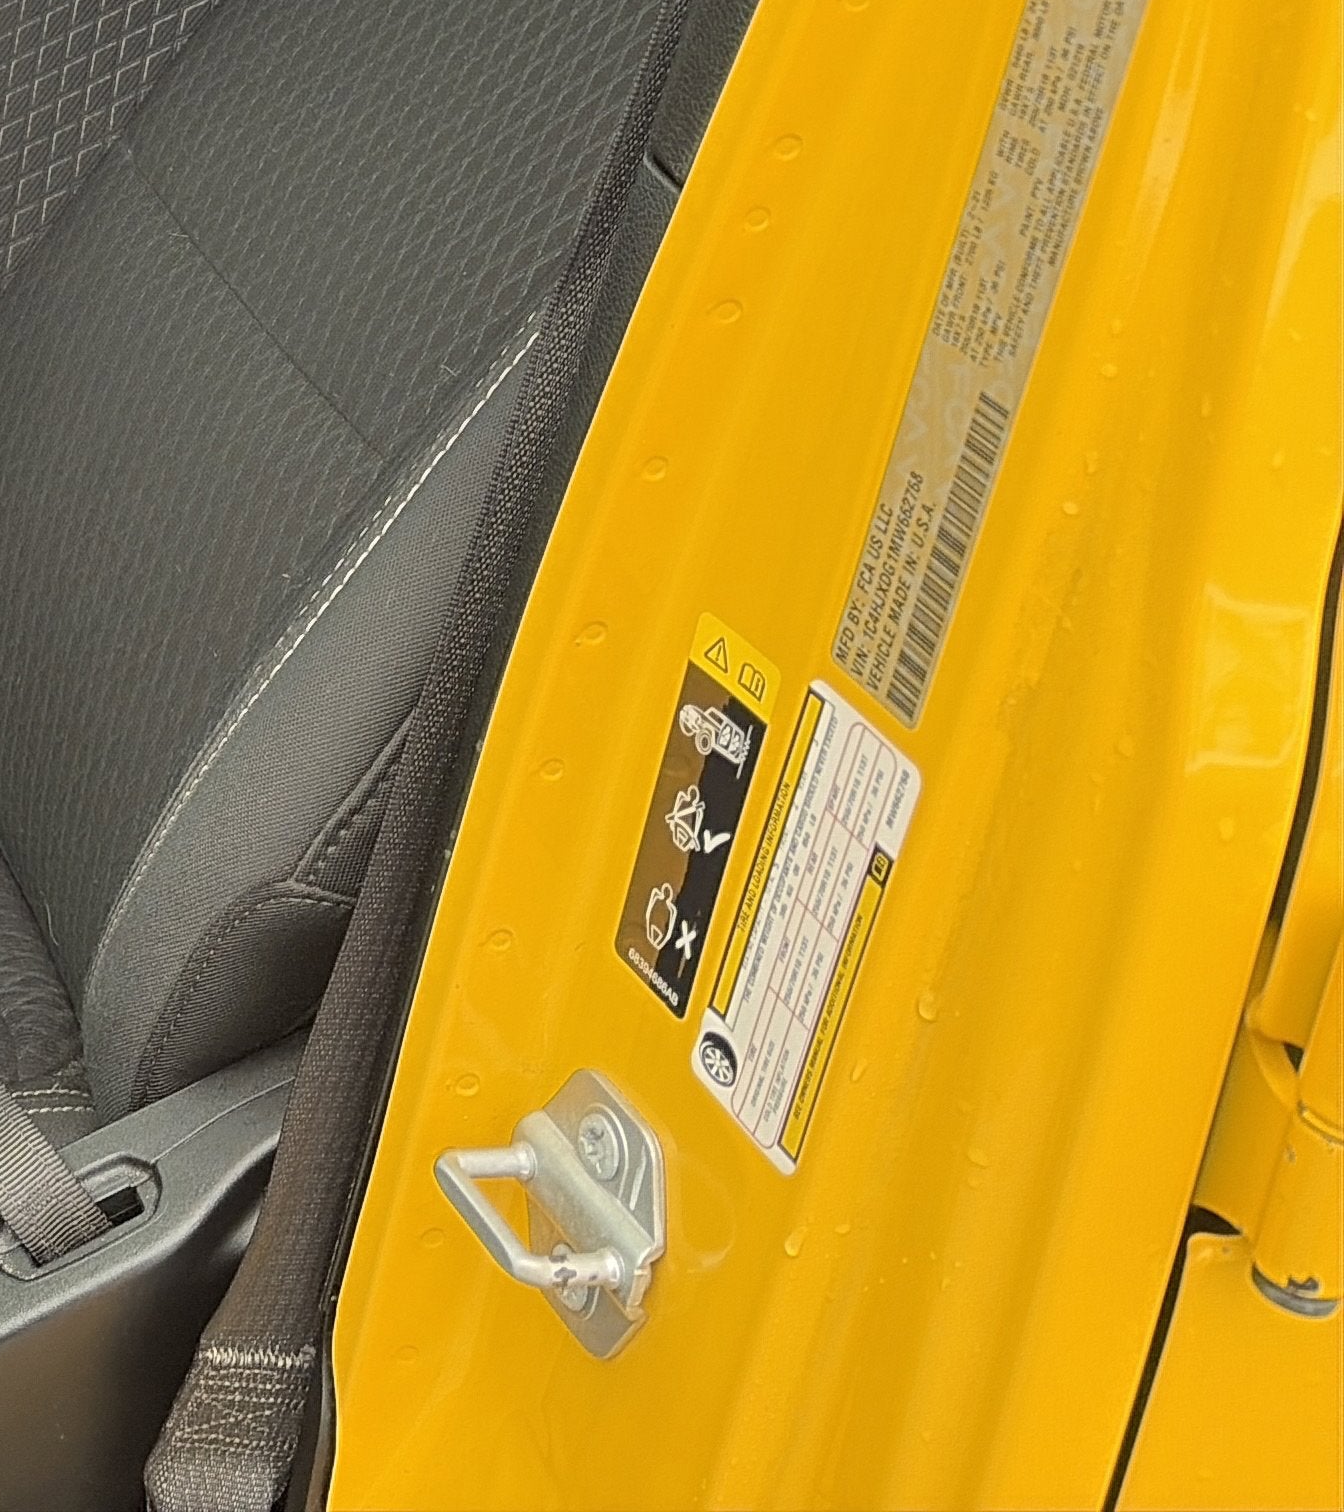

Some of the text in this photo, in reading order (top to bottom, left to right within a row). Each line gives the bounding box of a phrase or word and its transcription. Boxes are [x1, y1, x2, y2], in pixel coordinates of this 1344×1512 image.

[1077, 42, 1099, 90] FEDERAL
[1038, 119, 1048, 133] AT
[1045, 129, 1072, 194] APPLICABLE
[1008, 317, 1025, 357] SAFETY
[1021, 292, 1033, 315] AND
[1029, 256, 1044, 290] THEFT
[1040, 187, 1066, 253] PREVENTION
[1061, 120, 1087, 185] STANDARDS
[1087, 63, 1105, 103] EFFECT
[1100, 43, 1111, 59] ON
[1033, 219, 1044, 233] TO
[1038, 196, 1051, 216] ALL
[1048, 144, 1092, 266] MANUFACTURE SHOWN
[1015, 235, 1039, 293] CONFORMS
[931, 308, 945, 336] DATE
[940, 292, 950, 307] OF
[1001, 294, 1020, 337] VEHICLE
[968, 347, 979, 362] AT
[836, 501, 892, 665] MFD BY: FCA US LLC
[867, 495, 935, 694] VEHICLE MADE IN: U.S.A.
[851, 641, 870, 680] VIN:
[737, 780, 790, 932] TIRE AND LOADING INFORMATION
[825, 970, 844, 1018] ADDITIONAL
[841, 913, 863, 970] INFORMATION
